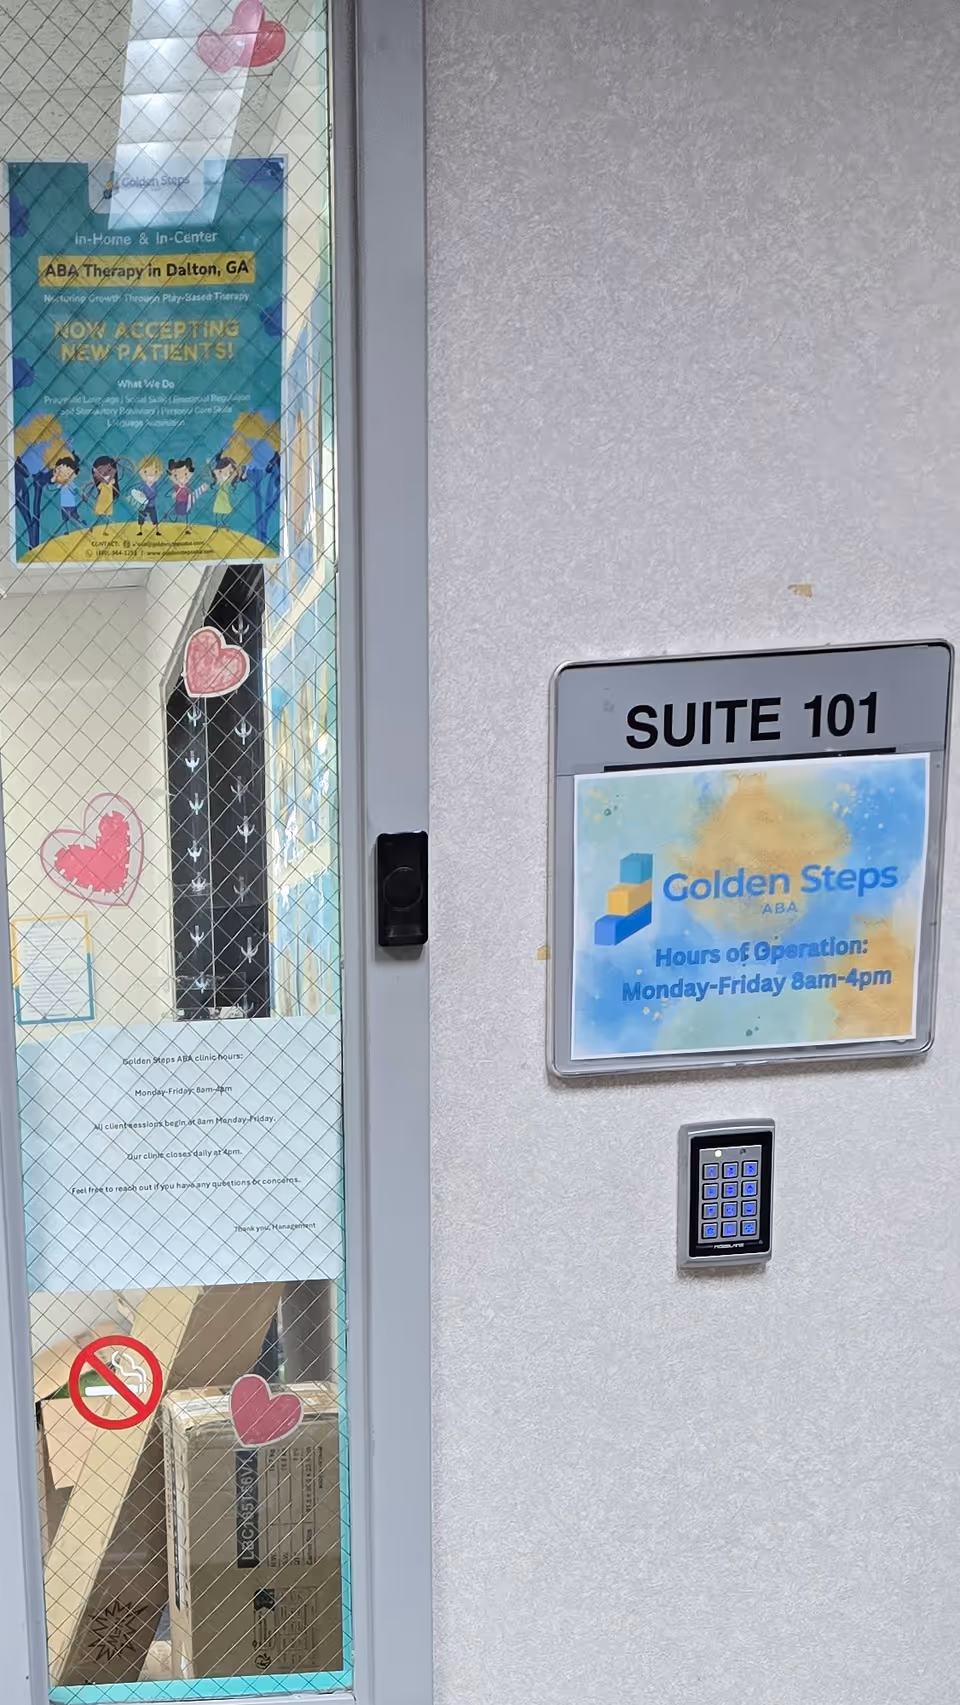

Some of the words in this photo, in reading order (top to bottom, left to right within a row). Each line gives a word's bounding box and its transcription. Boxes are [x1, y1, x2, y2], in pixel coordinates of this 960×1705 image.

[75, 232, 132, 245] In-Home
[139, 233, 149, 245] &
[156, 230, 218, 245] In-Center
[44, 263, 80, 278] ABA
[83, 263, 144, 280] Therapy
[148, 263, 161, 277] in
[166, 262, 222, 278] Dalton,
[226, 260, 249, 274] GA
[214, 291, 250, 302] Therapy
[53, 320, 107, 339] NOW
[114, 318, 240, 339] ACCEPTING
[61, 343, 111, 362] NEW
[118, 342, 234, 362] PATIENTS!
[117, 379, 142, 389] What
[144, 379, 160, 389] We
[162, 379, 175, 389] Do
[626, 696, 782, 750] SUITE
[804, 691, 878, 738] 101
[662, 867, 791, 902] Golden
[801, 863, 899, 897] Steps
[762, 901, 799, 915] ABA
[655, 946, 721, 967] Hours
[726, 942, 751, 962] of
[754, 936, 869, 965] Operation:
[622, 973, 787, 1002] Monday-Friday
[791, 967, 892, 992] 8am-4pm
[122, 1057, 151, 1065] Golden
[153, 1056, 175, 1065] Steps
[177, 1055, 193, 1063] ABA
[194, 1054, 217, 1062] clinic
[217, 1053, 244, 1061] hours:
[104, 1122, 128, 1131] client
[128, 1121, 163, 1130] sessions
[164, 1119, 186, 1128] begin
[215, 1115, 276, 1125] Monday-Friday.
[127, 1152, 142, 1161] Our
[143, 1151, 165, 1160] clinic
[165, 1151, 192, 1159] closes
[193, 1149, 212, 1158] daily
[223, 1148, 243, 1157] 4pm.
[71, 1187, 87, 1195] Feel
[88, 1185, 104, 1193] free
[105, 1185, 114, 1193] to
[115, 1184, 137, 1193] reach
[139, 1183, 153, 1191] out
[154, 1182, 160, 1190] if
[160, 1183, 175, 1191] you
[176, 1182, 195, 1190] have
[196, 1181, 211, 1189] any
[212, 1179, 251, 1188] questions
[233, 1225, 255, 1233] Thank
[272, 1222, 316, 1231] Management
